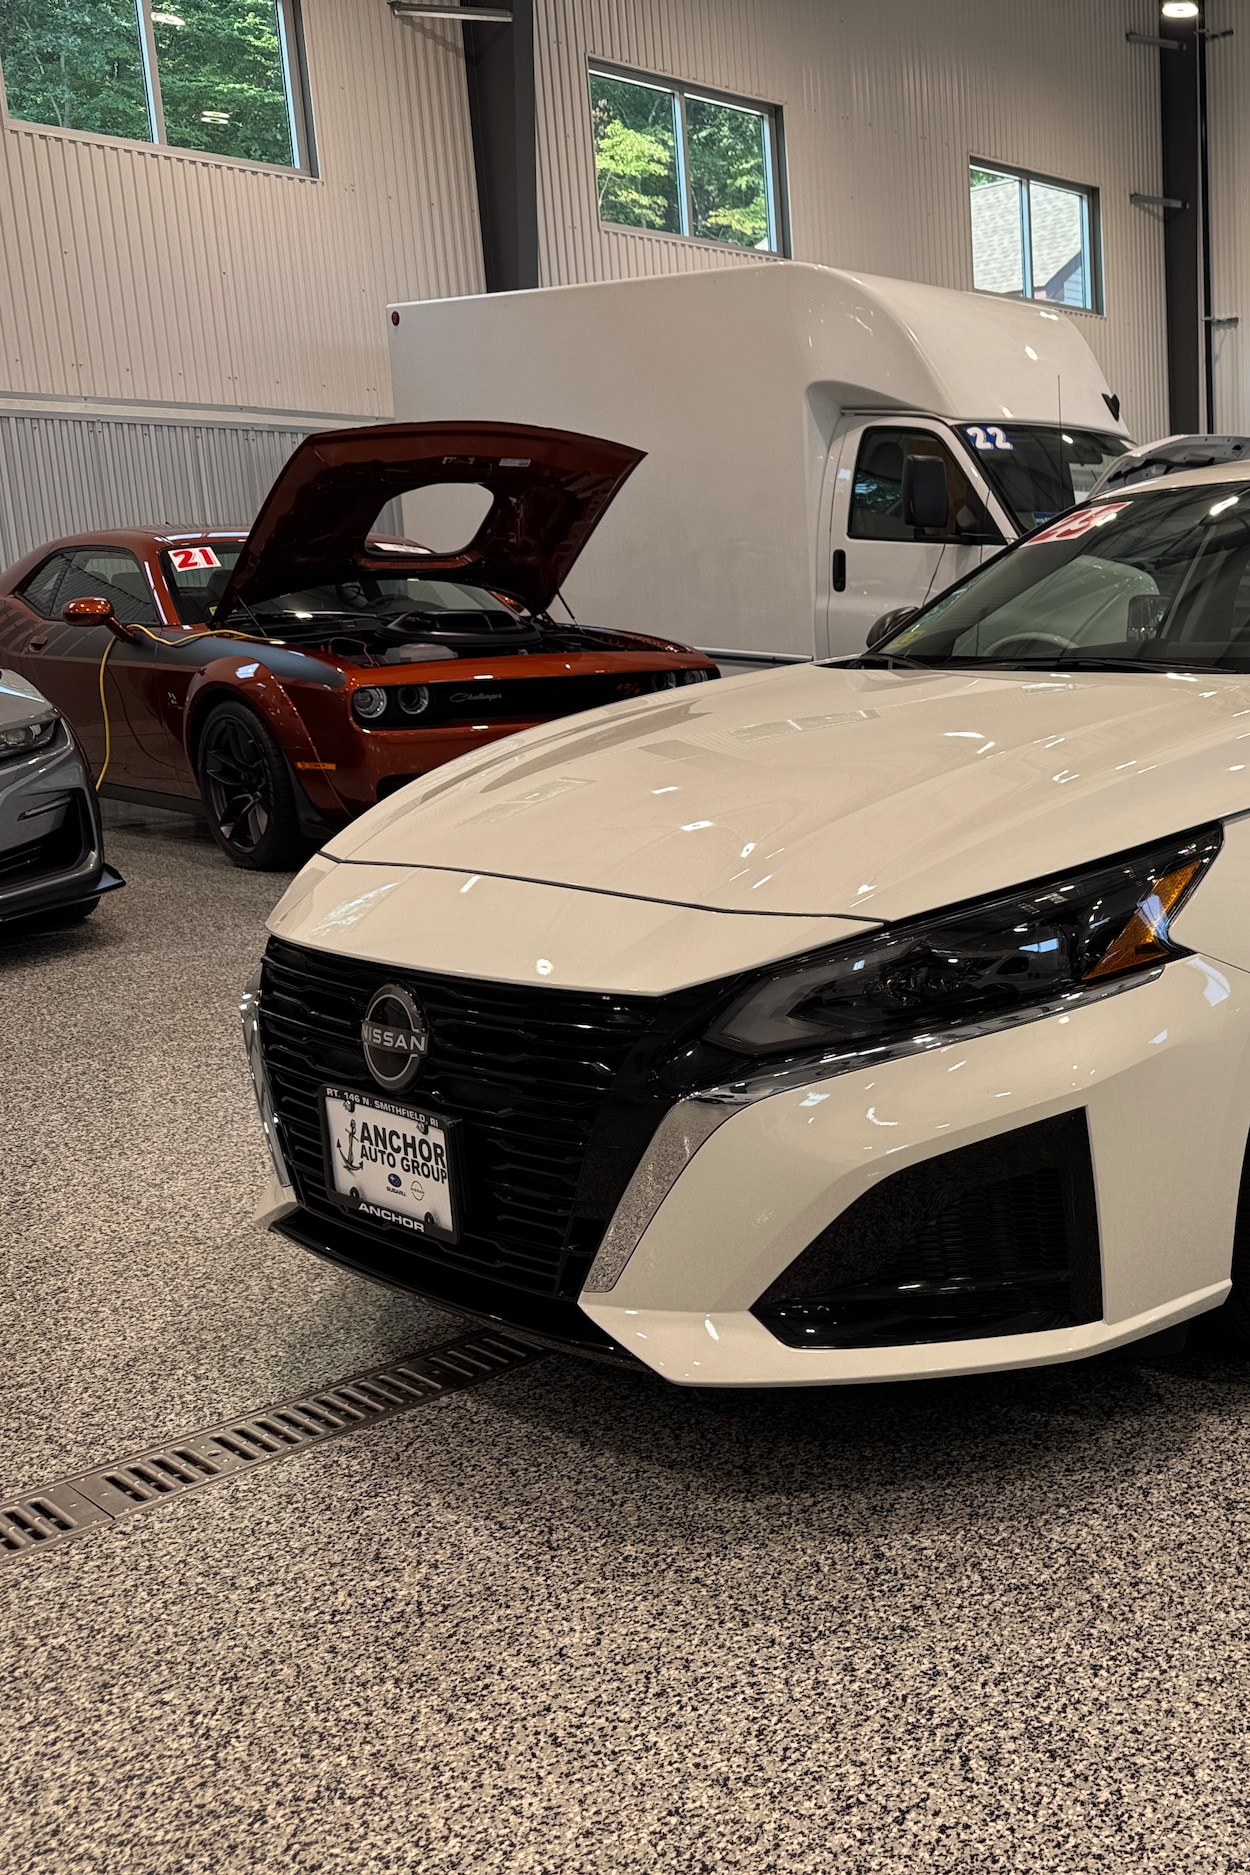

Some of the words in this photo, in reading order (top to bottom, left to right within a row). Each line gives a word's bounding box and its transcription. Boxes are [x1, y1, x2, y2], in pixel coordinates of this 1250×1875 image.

[966, 426, 1014, 450] 22
[172, 548, 216, 569] 21
[449, 691, 503, 704] Challenger
[361, 1024, 427, 1053] NISSAN
[326, 1087, 341, 1098] RT.
[344, 1092, 360, 1104] 146
[362, 1096, 373, 1106] N.
[430, 1117, 439, 1128] RI
[360, 1122, 446, 1169] ANCHOR
[360, 1145, 396, 1169] AUTO
[400, 1156, 448, 1185] GROUP
[358, 1202, 425, 1232] ANCHOR
